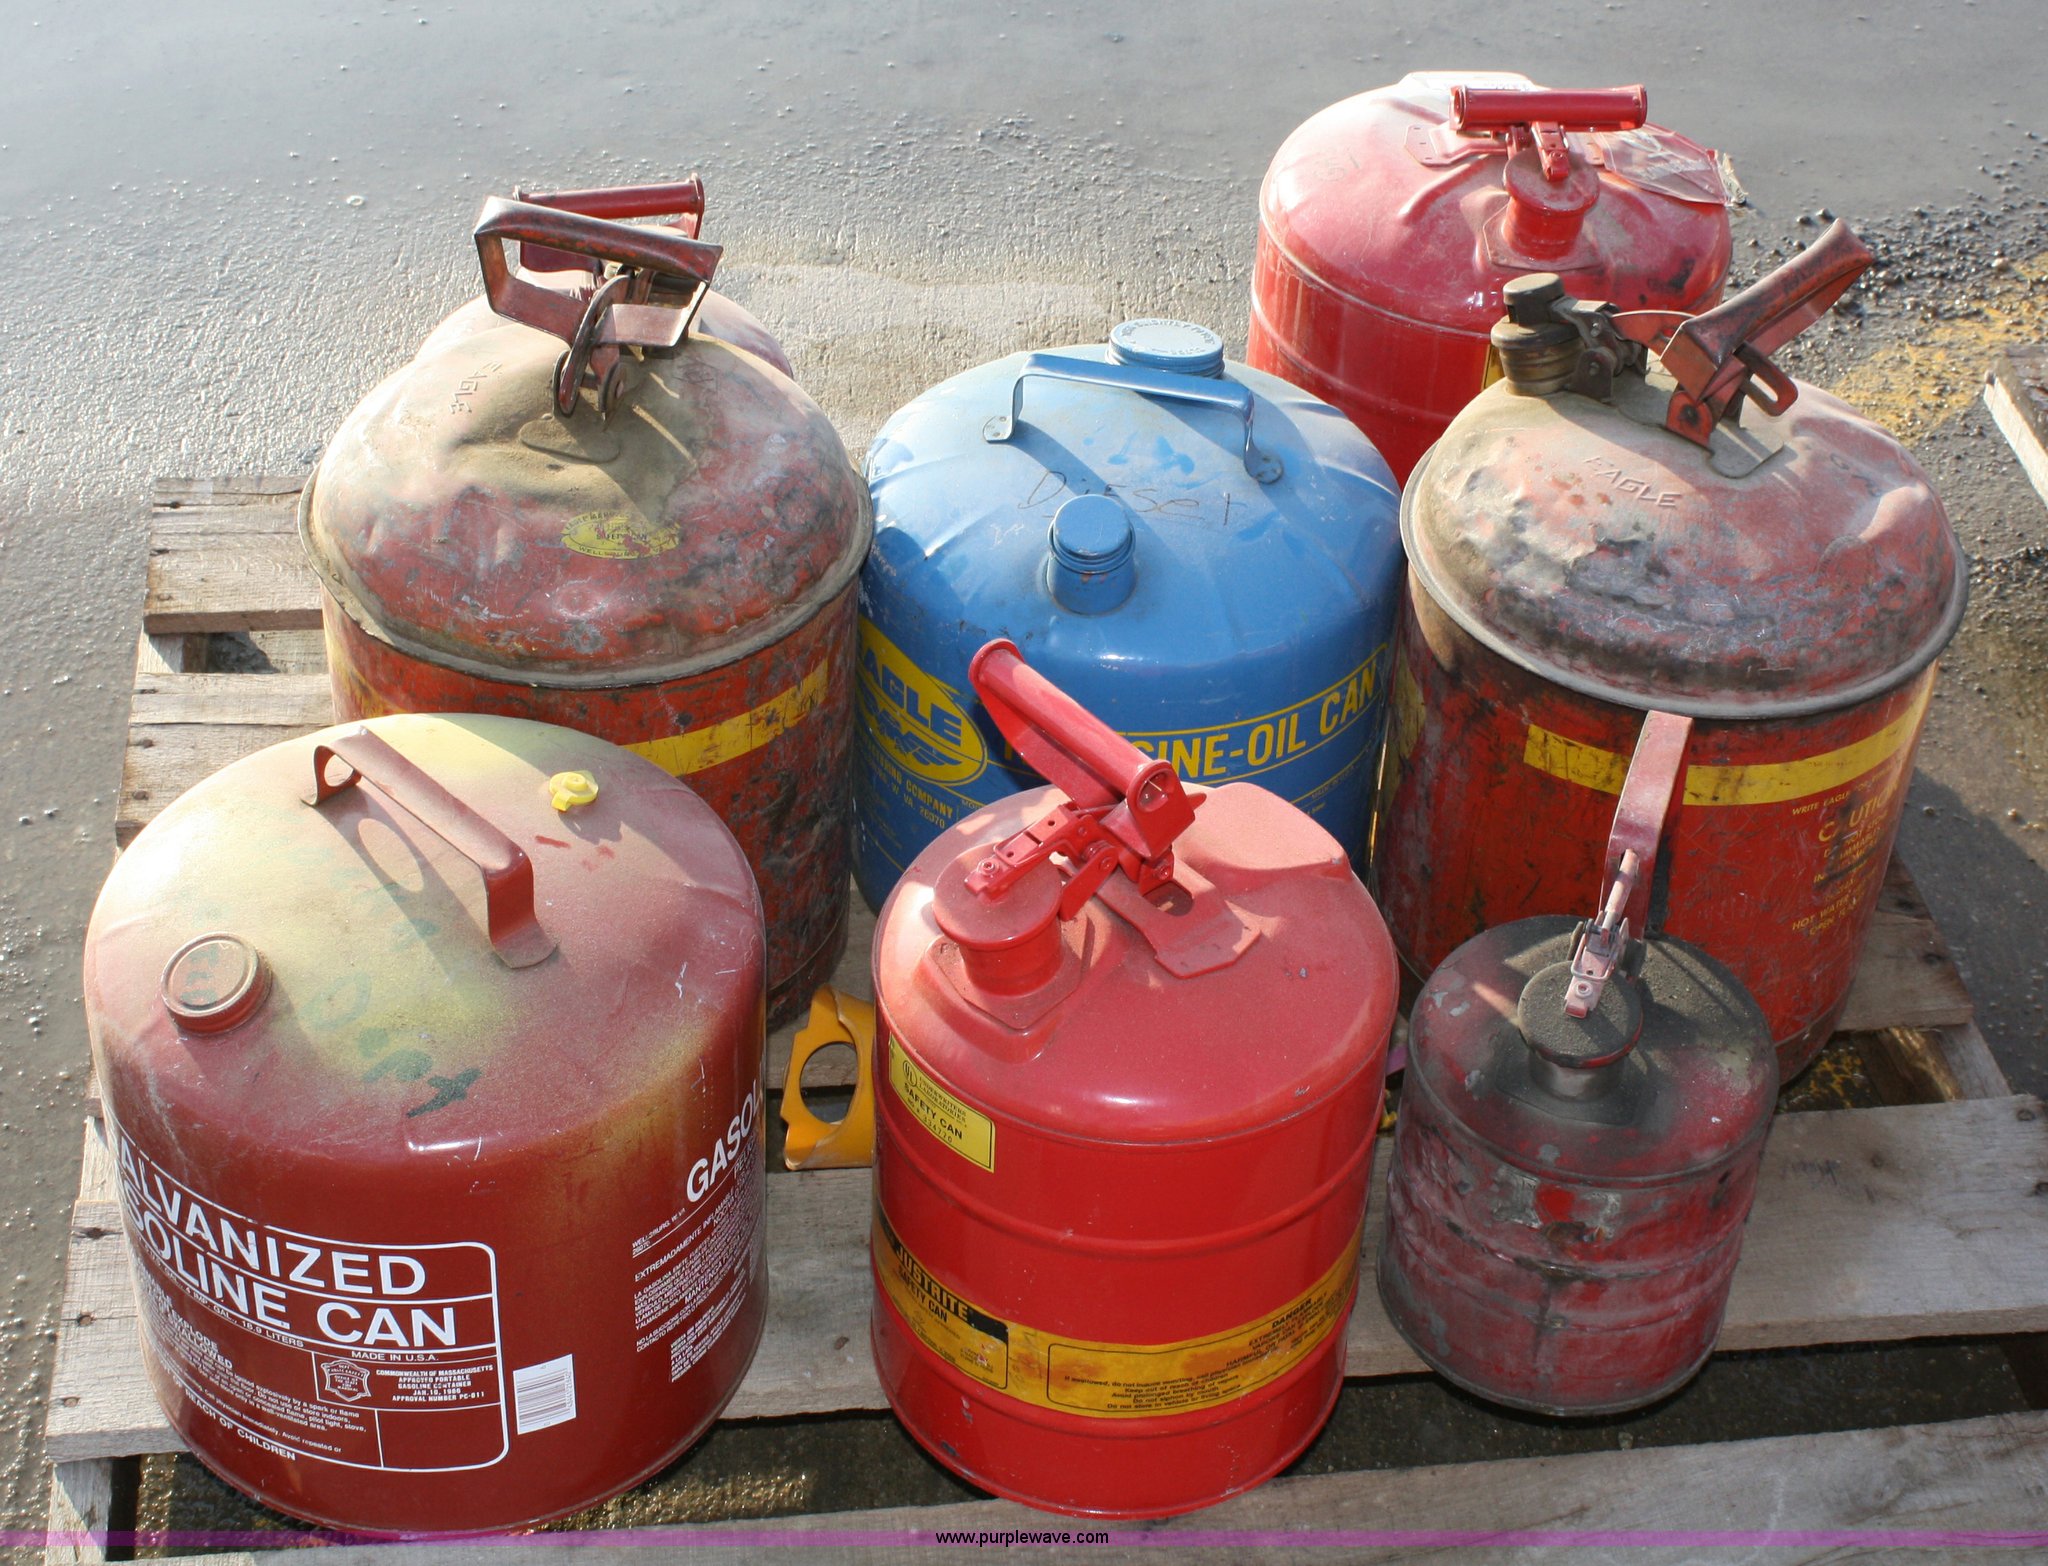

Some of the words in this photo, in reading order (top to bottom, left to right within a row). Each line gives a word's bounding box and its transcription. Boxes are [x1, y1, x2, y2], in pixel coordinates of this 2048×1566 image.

[863, 647, 962, 747] AGLE
[1130, 713, 1306, 778] INE-OIL
[1320, 660, 1376, 735] CAN
[1792, 802, 1819, 815] WRITE
[904, 1082, 936, 1119] SAFETY
[940, 1118, 963, 1139] CAN
[121, 1137, 425, 1295] ALVANIZED
[123, 1180, 290, 1330] SOLINE
[316, 1302, 456, 1348] CAN
[634, 1225, 702, 1282] EXTREMADAMENTE
[895, 1244, 968, 1322] JUSTRITE
[928, 1300, 948, 1323] CAN
[1271, 1298, 1312, 1328] DANGER
[242, 1321, 262, 1334] 18.9
[265, 1330, 304, 1348] LITERS
[352, 1351, 385, 1361] MADE
[390, 1353, 401, 1361] IN
[405, 1353, 439, 1362] U.S.A.
[376, 1369, 427, 1377] COMMONWEALTH
[438, 1364, 494, 1376] MASSACHUSETTS
[435, 1374, 470, 1383] PORTABLE
[302, 1406, 320, 1417] store
[309, 1402, 328, 1414] spark
[339, 1409, 360, 1418] flame
[185, 1388, 217, 1419] REACH
[219, 1417, 235, 1430] OF
[237, 1429, 296, 1461] CHILDREN
[302, 1439, 332, 1451] repeated
